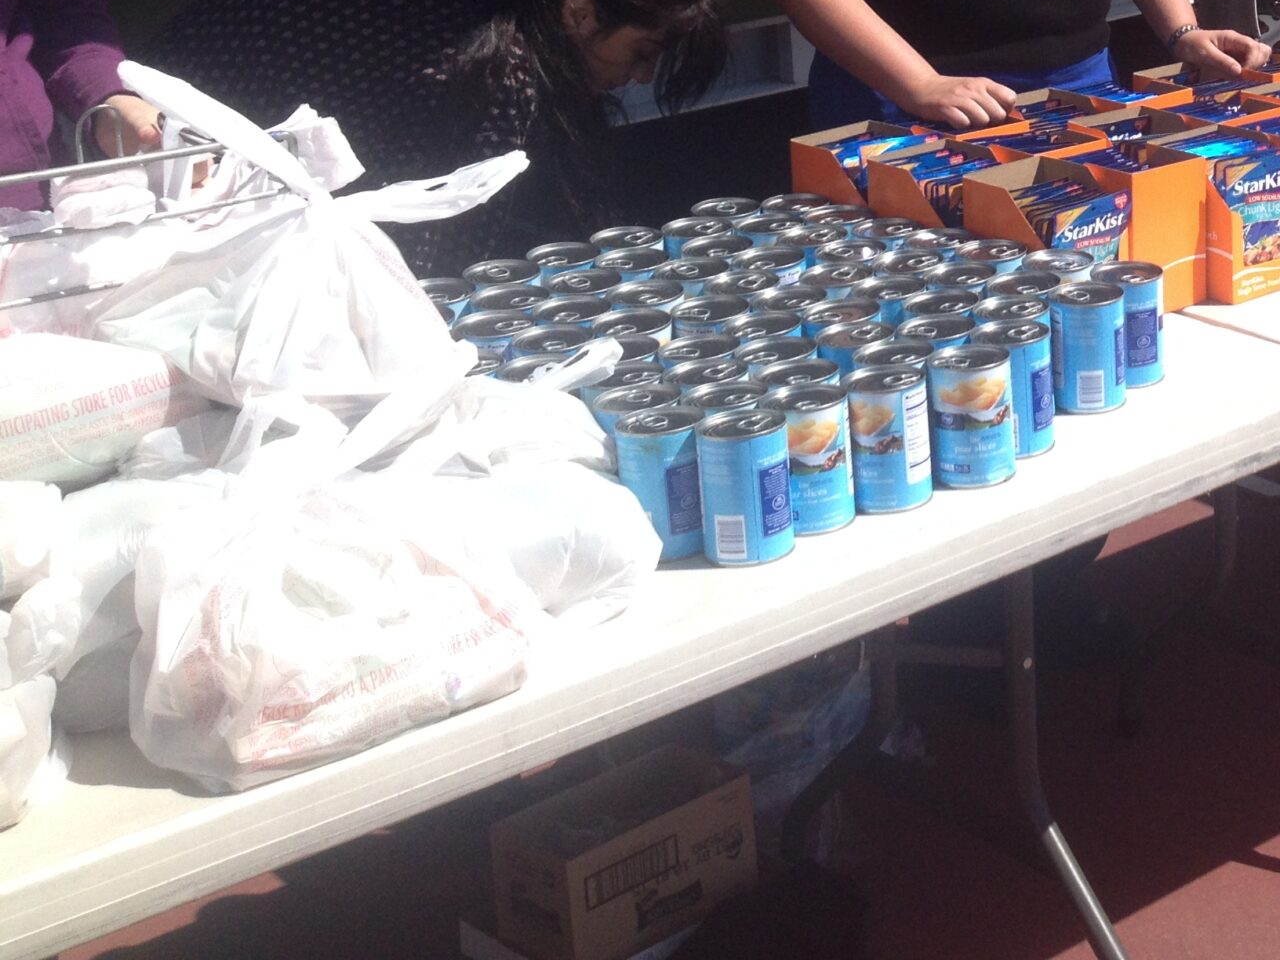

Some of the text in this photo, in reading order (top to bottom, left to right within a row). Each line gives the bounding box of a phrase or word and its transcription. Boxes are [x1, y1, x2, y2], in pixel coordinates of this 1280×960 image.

[1238, 201, 1267, 217] Chunk
[1061, 210, 1125, 243] StarKist
[71, 391, 108, 418] STORE
[108, 382, 132, 406] FOR
